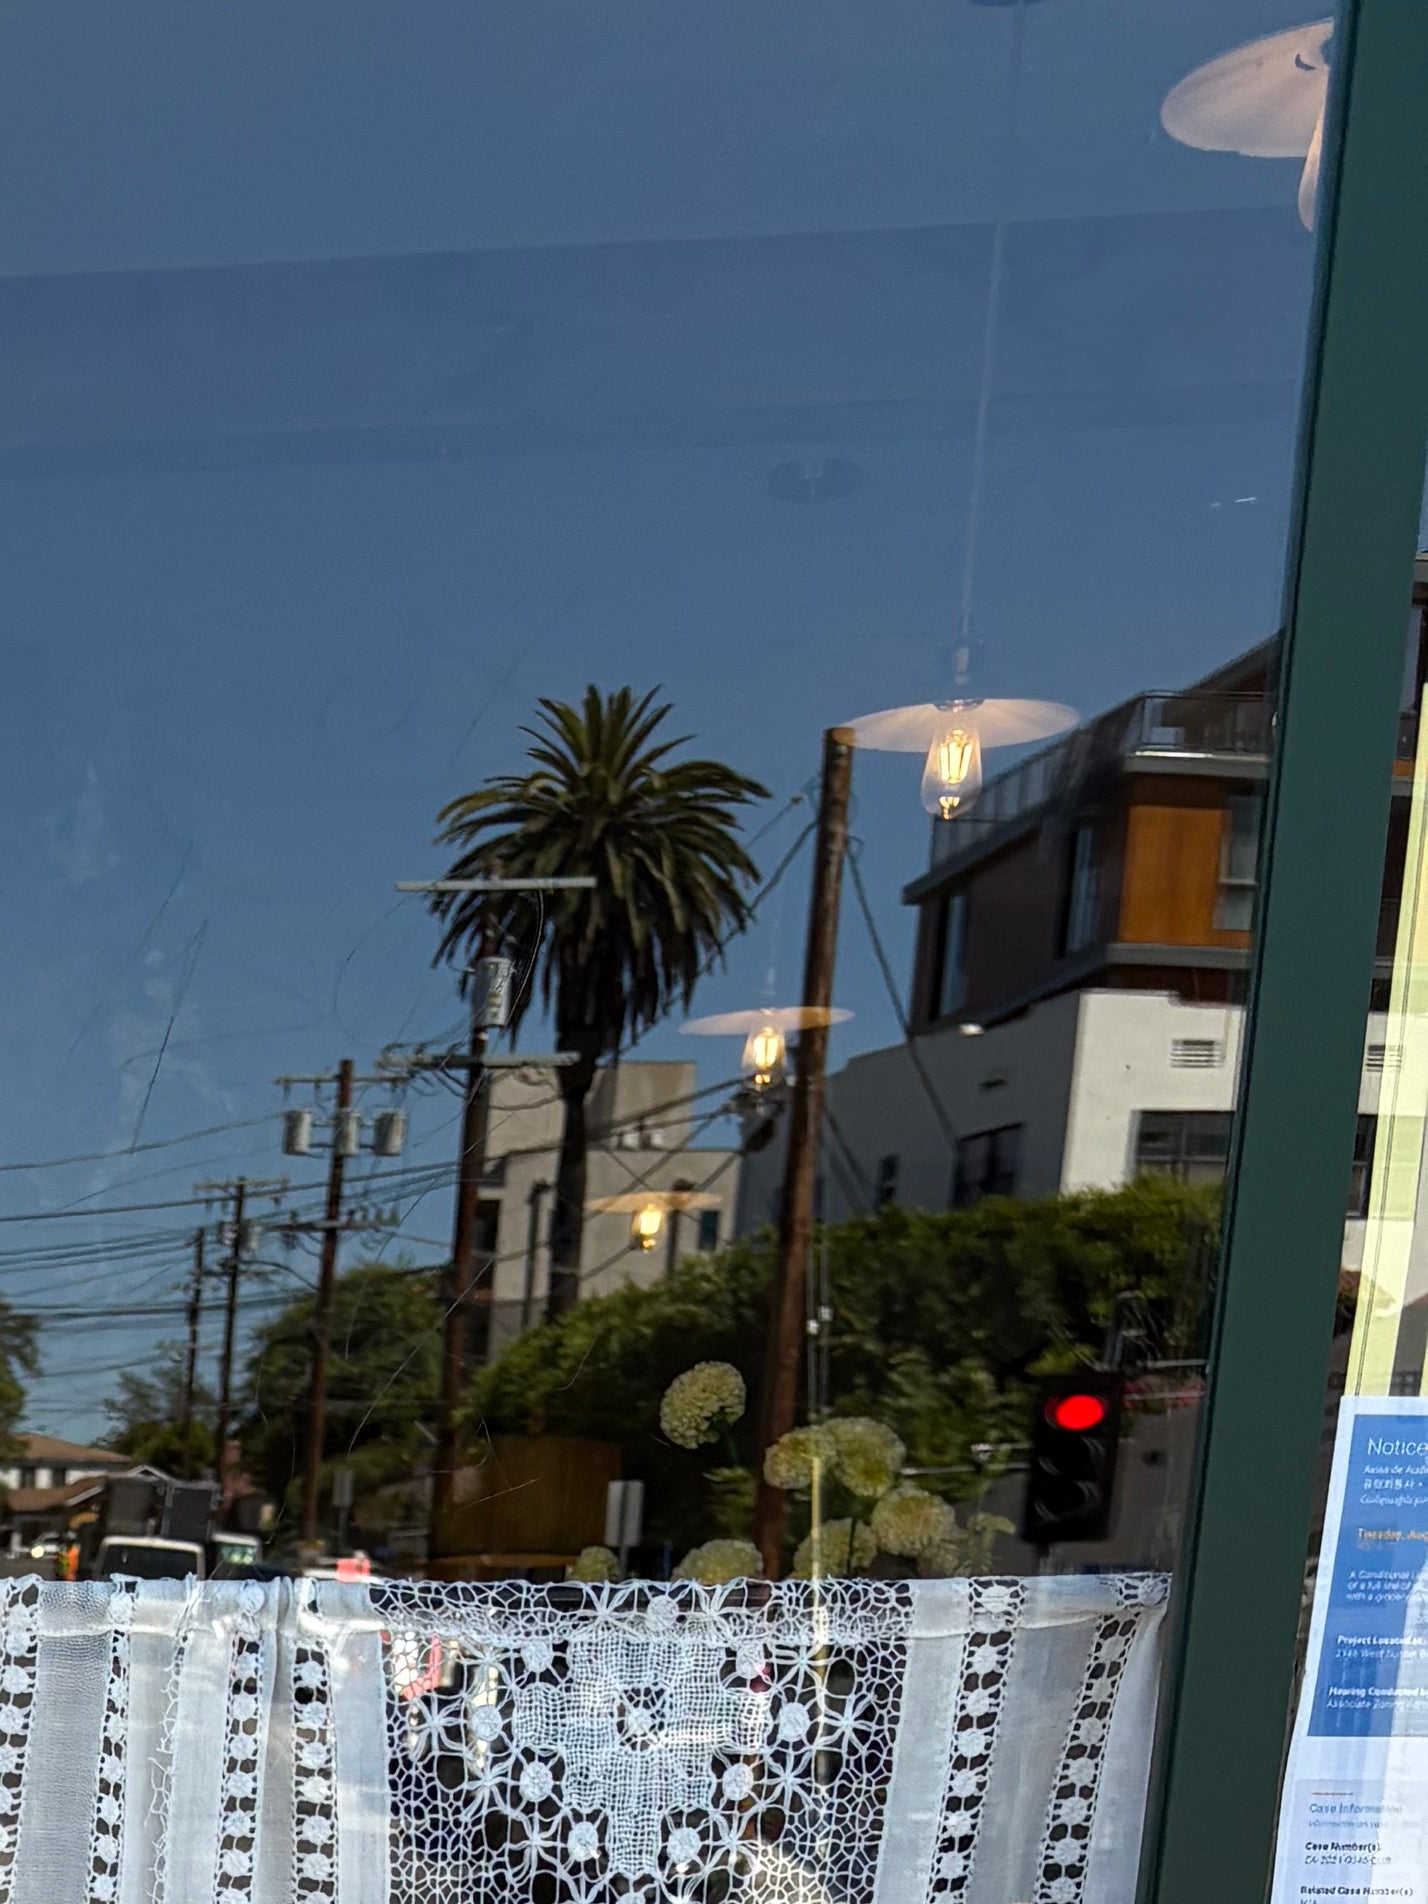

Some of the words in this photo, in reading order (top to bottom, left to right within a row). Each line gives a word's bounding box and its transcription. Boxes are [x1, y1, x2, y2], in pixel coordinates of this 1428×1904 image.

[1367, 1437, 1428, 1456] Notice
[1337, 1635, 1372, 1647] Project
[1309, 1803, 1337, 1814] Case
